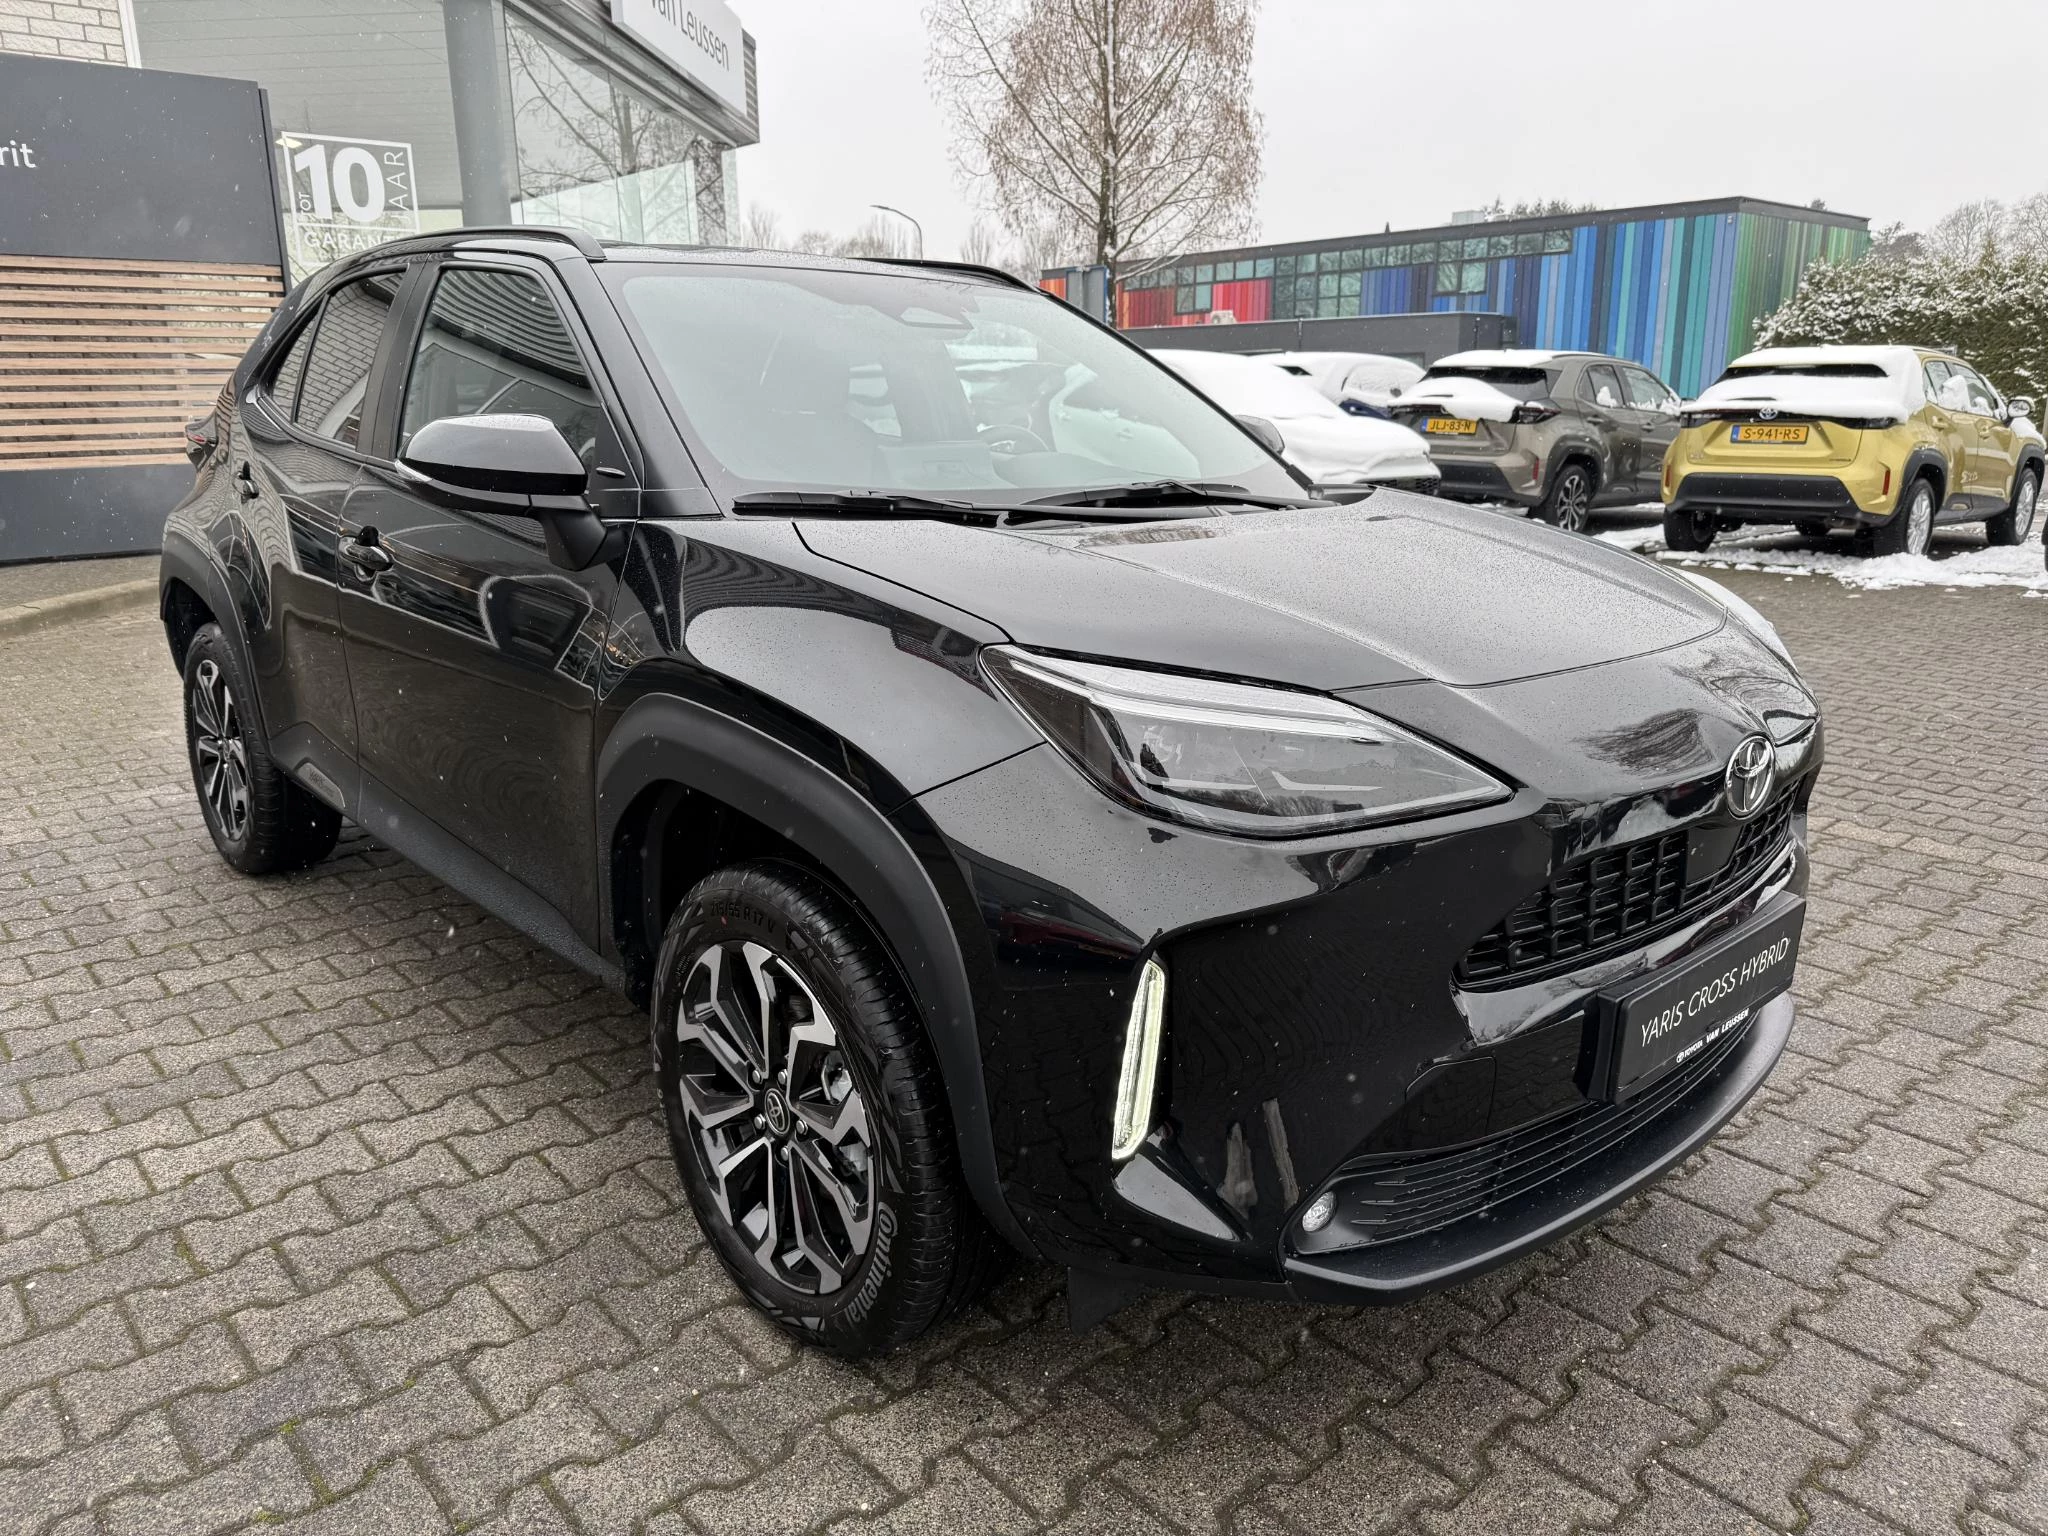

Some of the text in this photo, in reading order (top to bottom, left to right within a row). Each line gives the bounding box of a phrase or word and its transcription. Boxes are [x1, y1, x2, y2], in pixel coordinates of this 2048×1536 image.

[679, 0, 729, 72] Leussen
[294, 144, 385, 222] 10
[298, 191, 312, 220] TOT
[383, 151, 411, 220] JAAR
[1743, 428, 1801, 440] S-941-RS
[1641, 937, 1790, 1048] YARIS CROSS HYBRID
[1706, 1028, 1720, 1044] VAN
[1721, 1007, 1750, 1034] LEUSSEN
[844, 1201, 898, 1329] Continental
